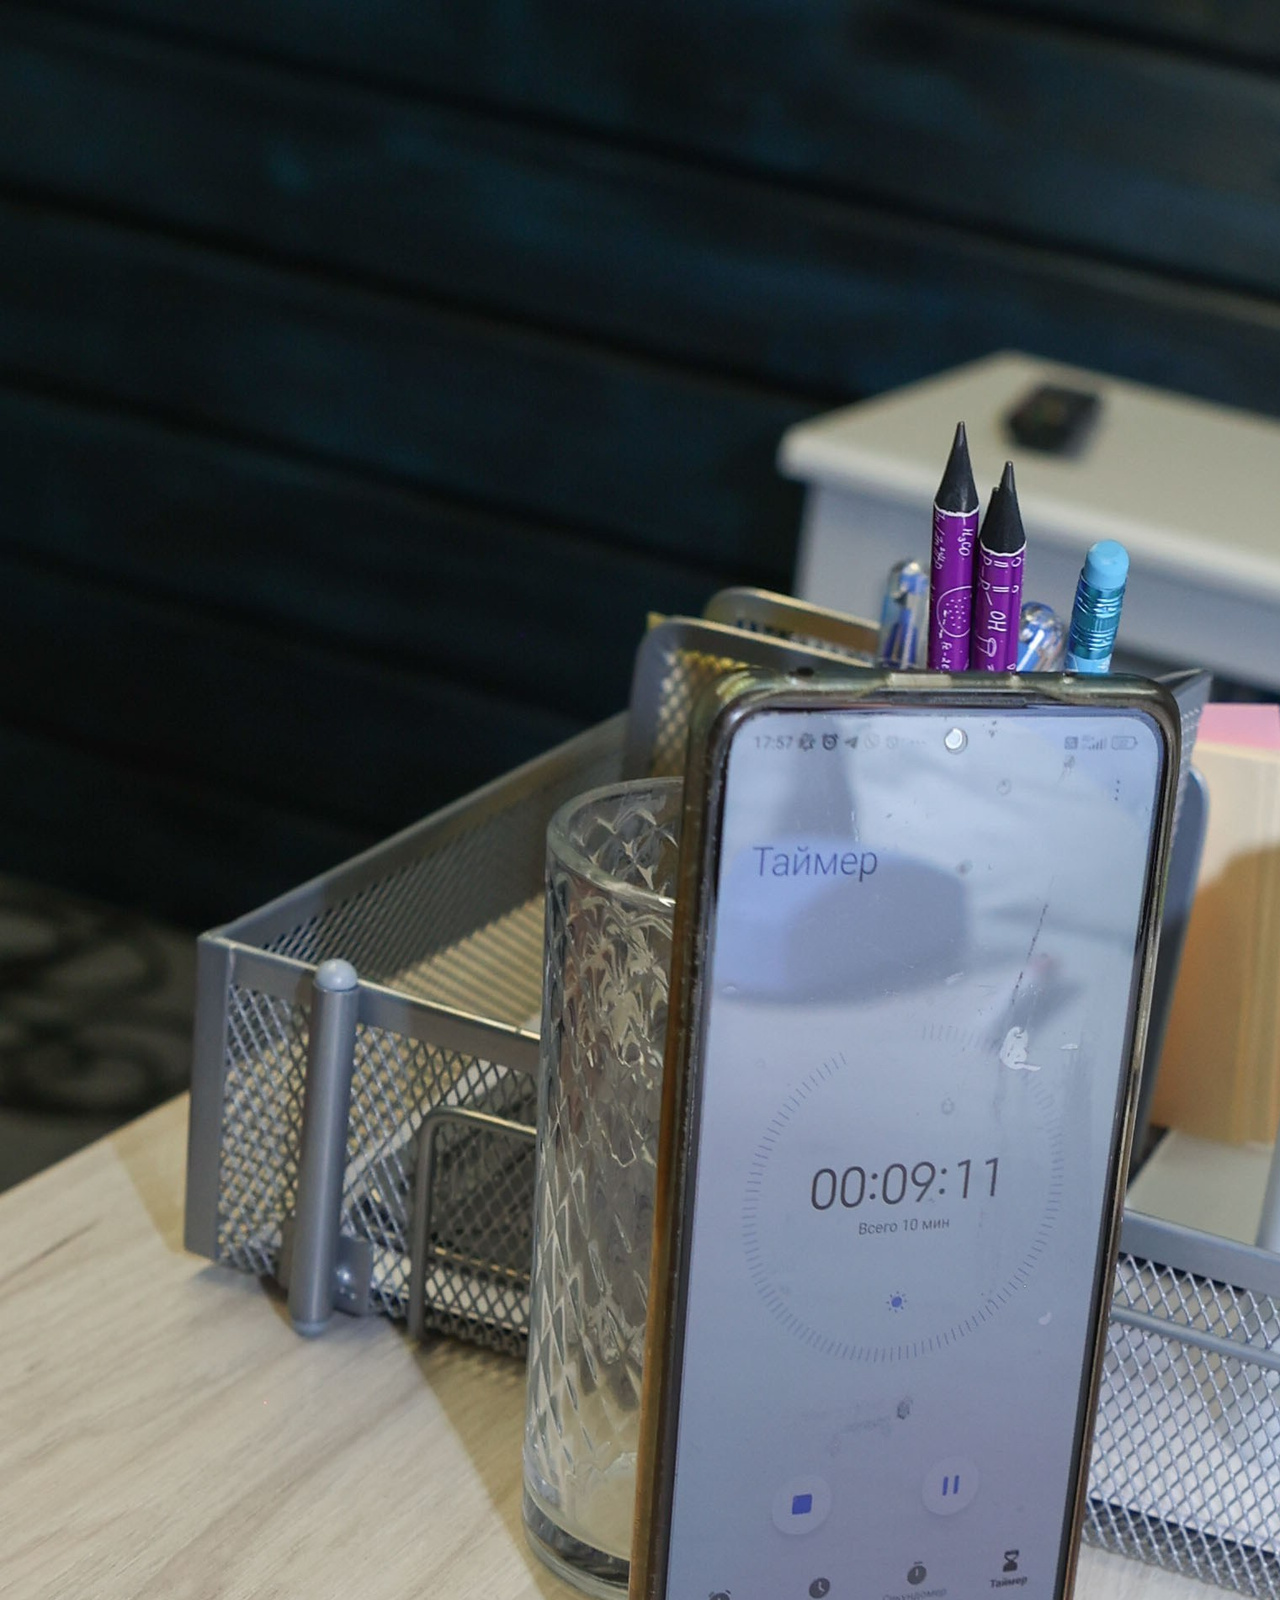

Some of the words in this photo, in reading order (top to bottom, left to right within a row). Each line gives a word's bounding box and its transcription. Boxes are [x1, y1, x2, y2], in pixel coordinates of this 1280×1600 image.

[755, 736, 793, 749] 17:57
[753, 846, 878, 882] Таймер
[810, 1157, 999, 1211] 00:09:11
[859, 1221, 898, 1235] Всего
[903, 1218, 918, 1231] 10
[922, 1218, 950, 1231] мин
[990, 1576, 1028, 1588] Таймер
